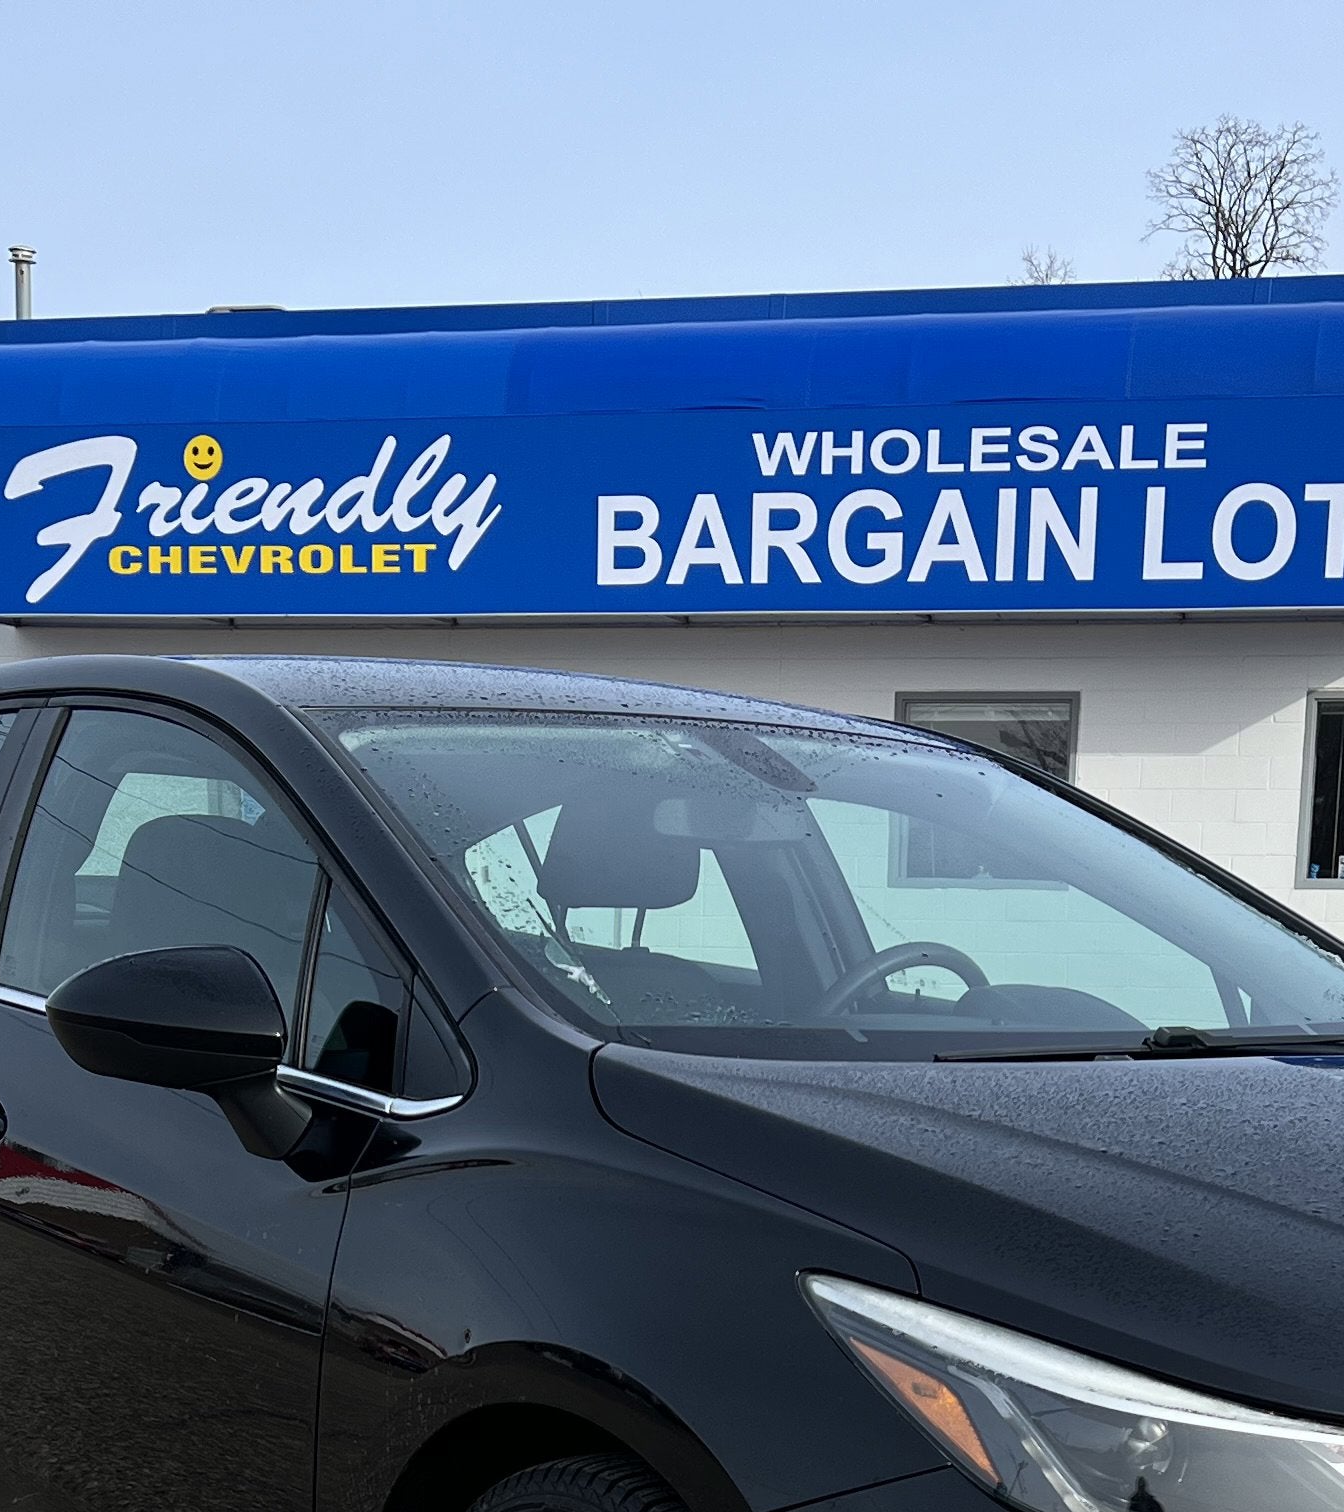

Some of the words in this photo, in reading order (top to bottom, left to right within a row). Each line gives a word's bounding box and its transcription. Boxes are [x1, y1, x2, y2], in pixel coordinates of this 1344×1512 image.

[751, 422, 1210, 477] WHOLESALE
[3, 433, 503, 605] Friendly
[595, 485, 1100, 587] BARGAIN
[107, 543, 438, 575] CHEVROLET
